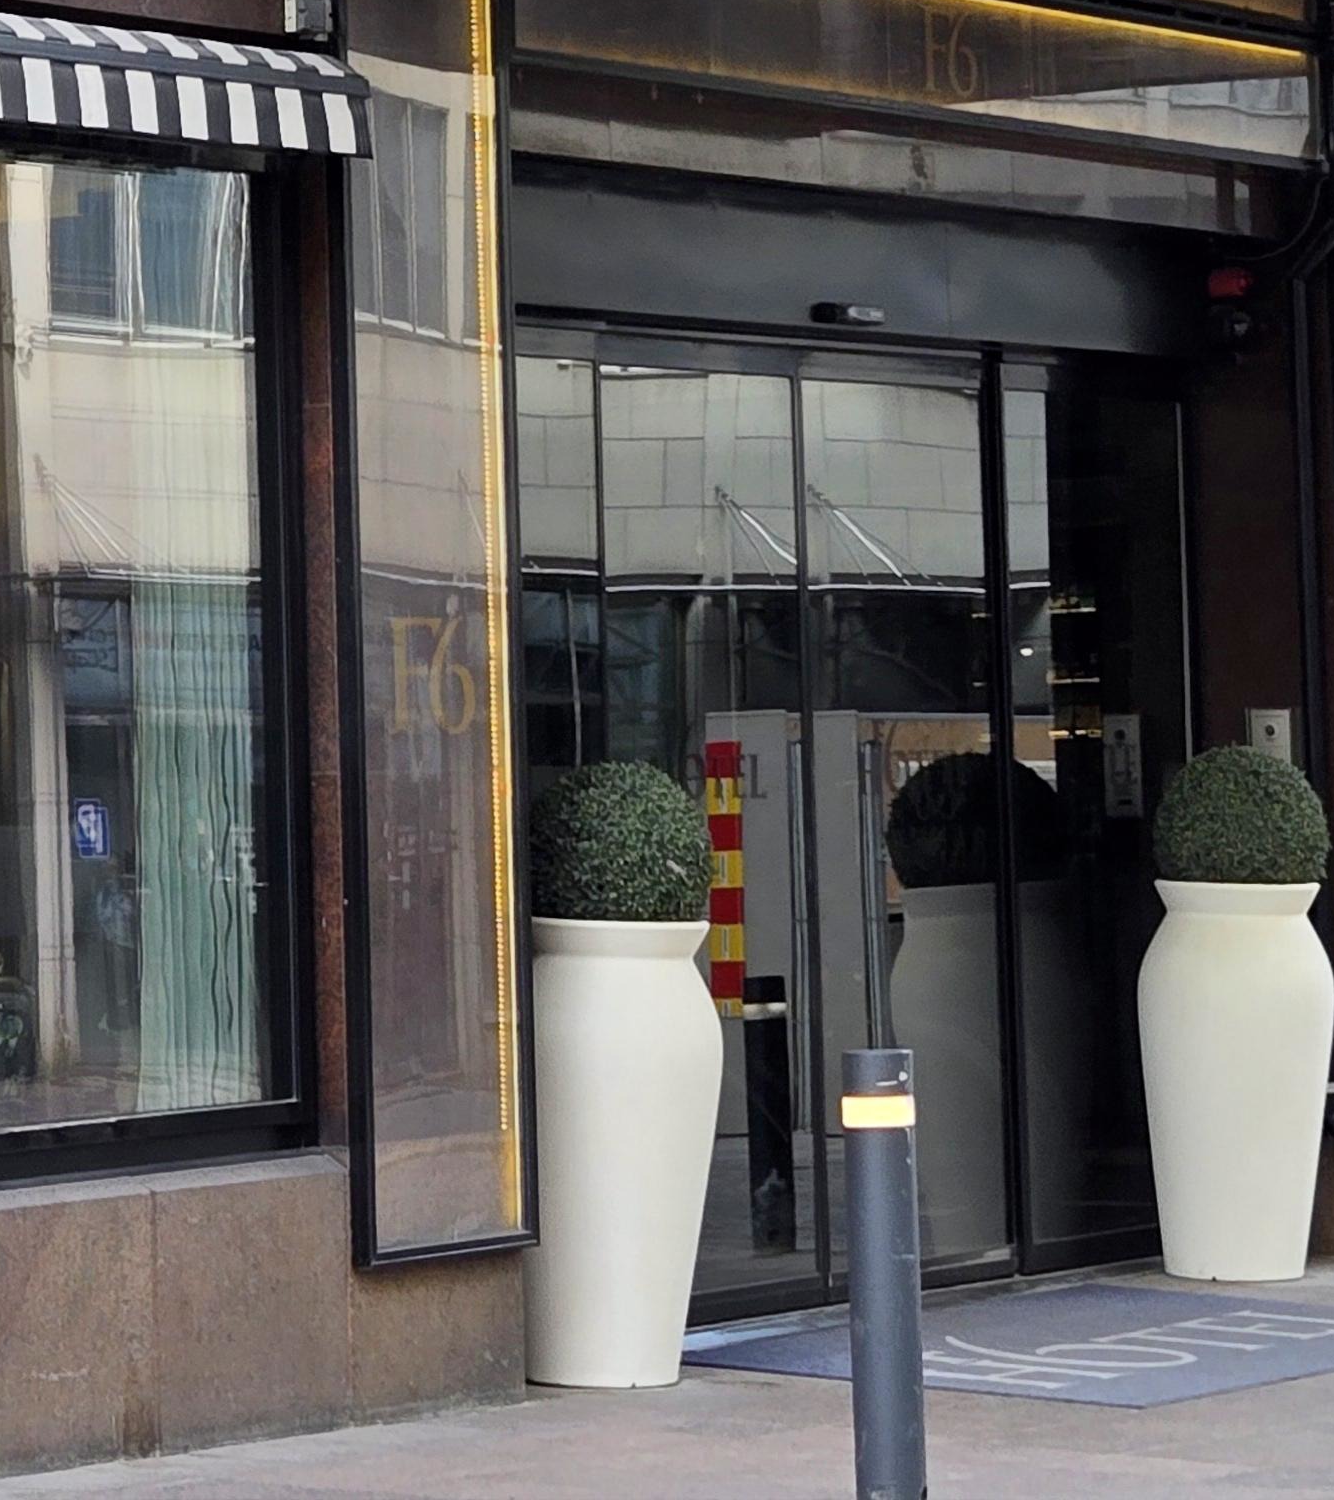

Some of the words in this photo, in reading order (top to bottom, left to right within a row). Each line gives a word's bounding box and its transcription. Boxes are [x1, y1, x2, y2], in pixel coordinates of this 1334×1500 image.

[917, 2, 979, 98] F6
[389, 614, 476, 736] F6
[683, 752, 768, 800] OTEL
